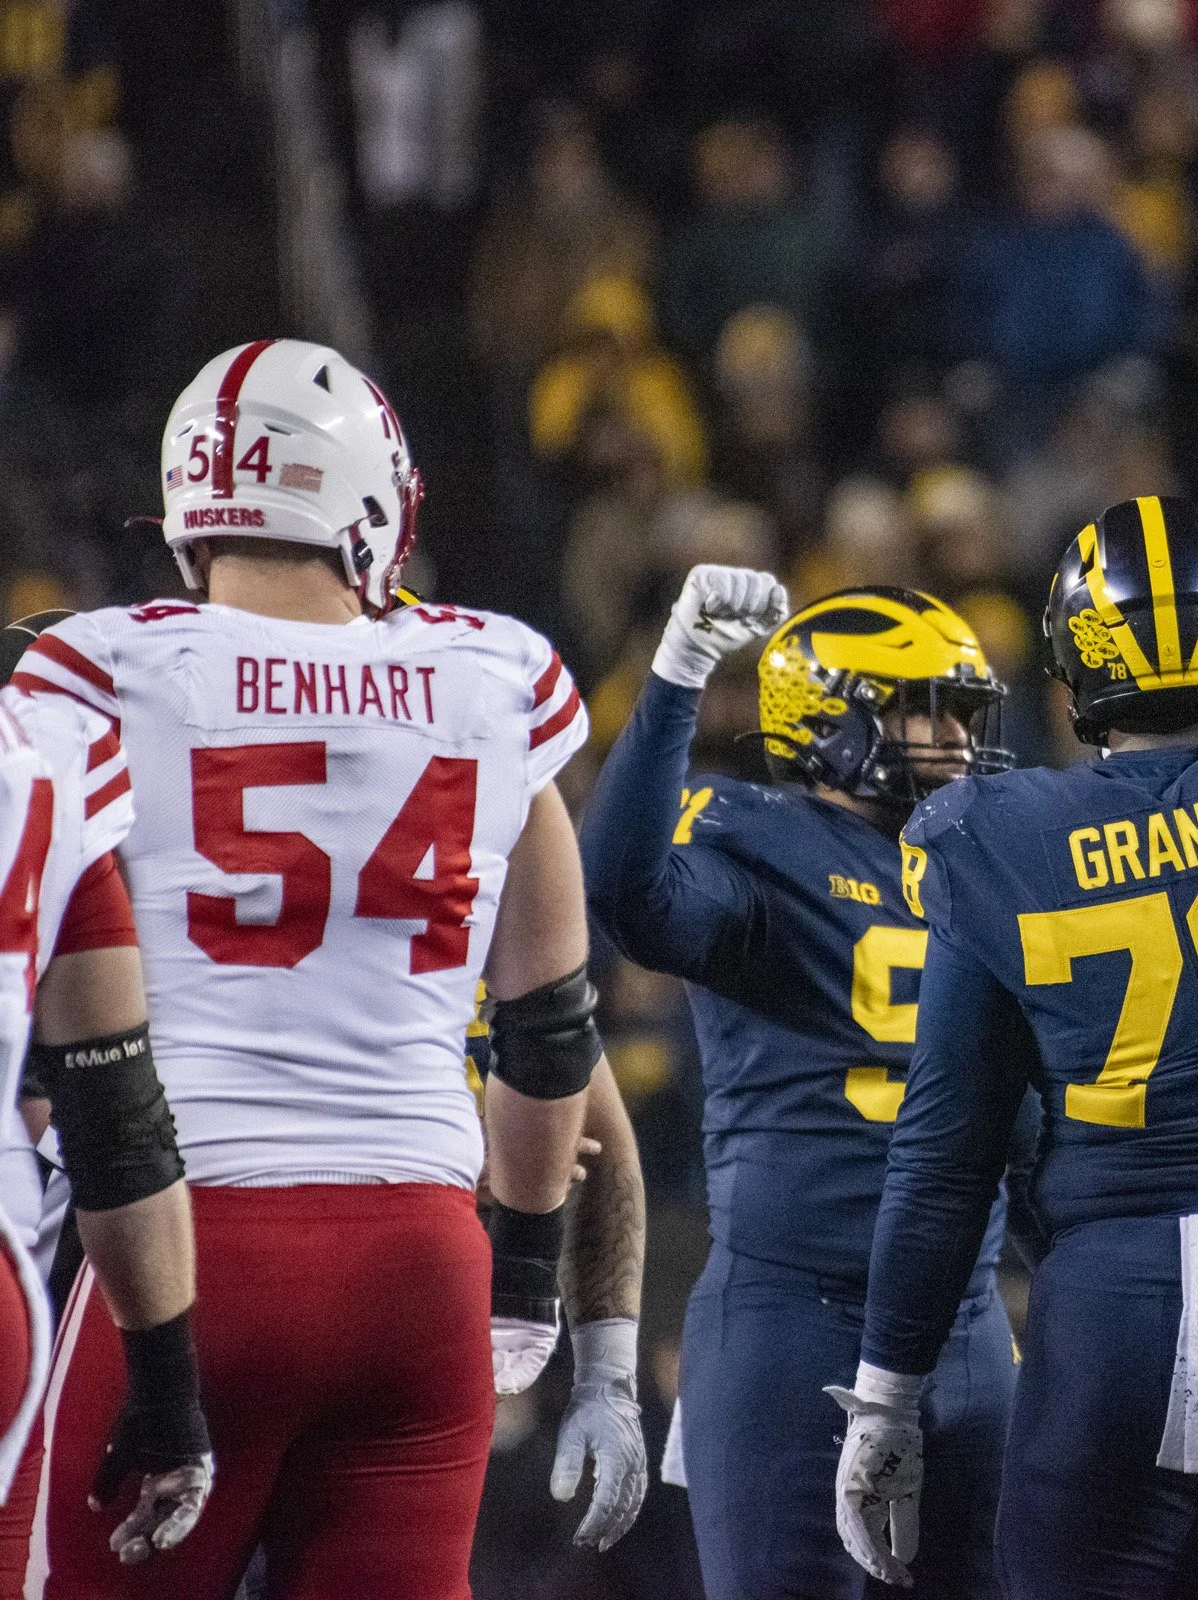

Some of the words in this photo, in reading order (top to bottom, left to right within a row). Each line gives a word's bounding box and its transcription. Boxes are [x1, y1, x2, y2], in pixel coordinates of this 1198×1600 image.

[183, 506, 267, 530] HUSKERS
[236, 656, 436, 725] BENHART
[1107, 662, 1128, 680] 78
[186, 740, 481, 975] 54
